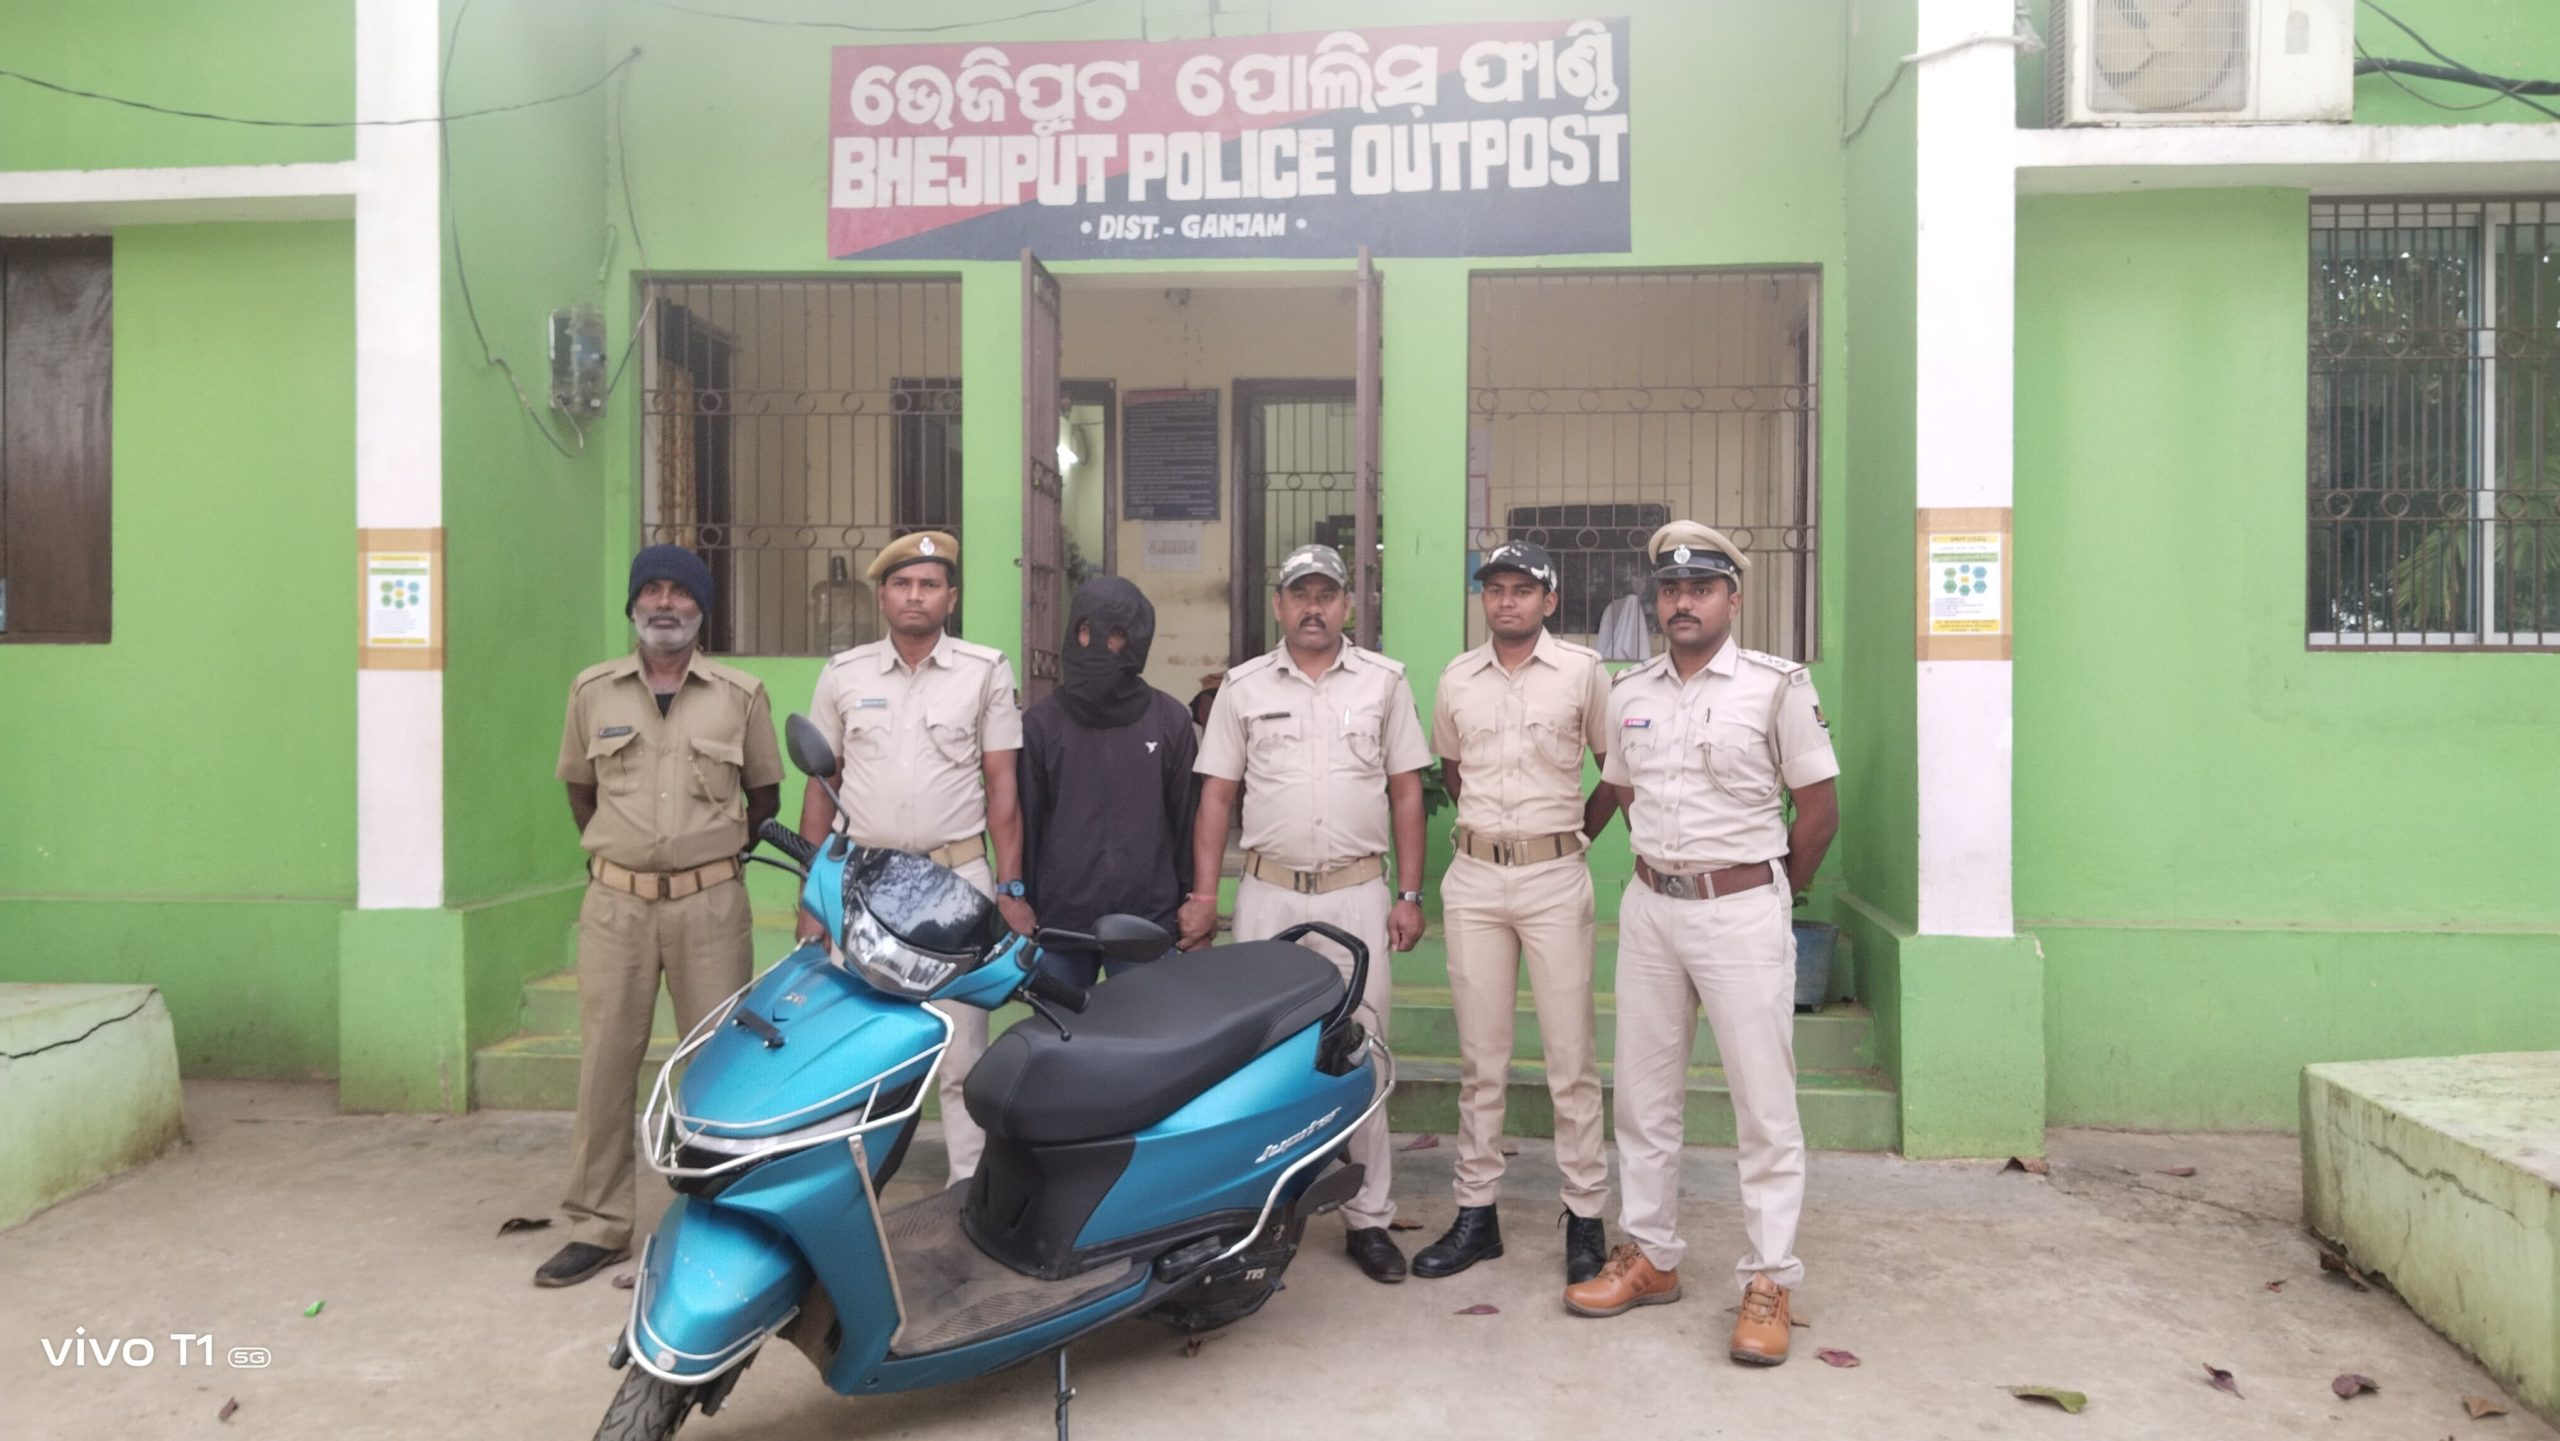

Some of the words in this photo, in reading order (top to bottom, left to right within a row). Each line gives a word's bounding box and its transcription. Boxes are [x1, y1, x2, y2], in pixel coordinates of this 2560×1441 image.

[831, 134, 1118, 208] BHEJIPUT
[1128, 128, 1336, 201] POLICE
[1350, 114, 1628, 195] OUTPOST
[1181, 213, 1286, 239] GANJAM
[1244, 1267, 1267, 1280] TVS
